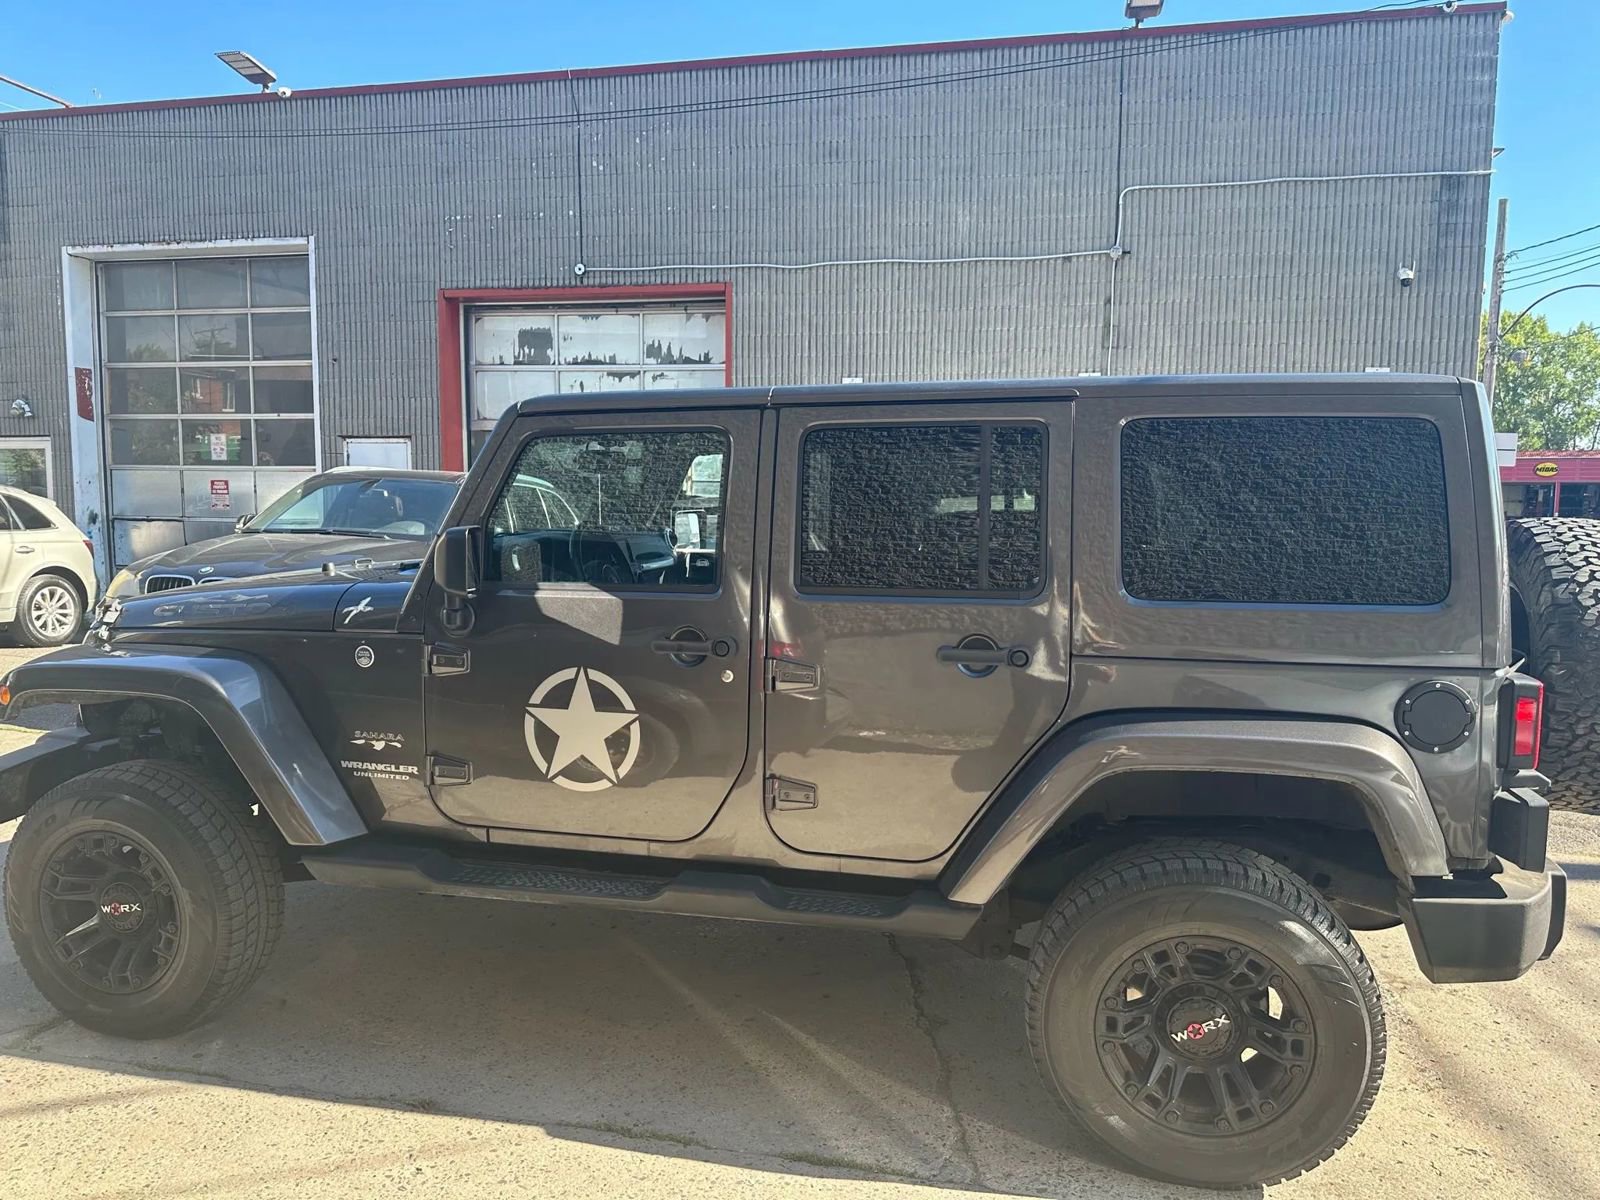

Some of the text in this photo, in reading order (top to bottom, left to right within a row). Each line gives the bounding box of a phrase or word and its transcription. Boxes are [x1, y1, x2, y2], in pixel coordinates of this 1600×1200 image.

[354, 730, 405, 741] SAHARA
[340, 760, 419, 774] WRANGLER
[353, 771, 410, 780] UNLIMITED
